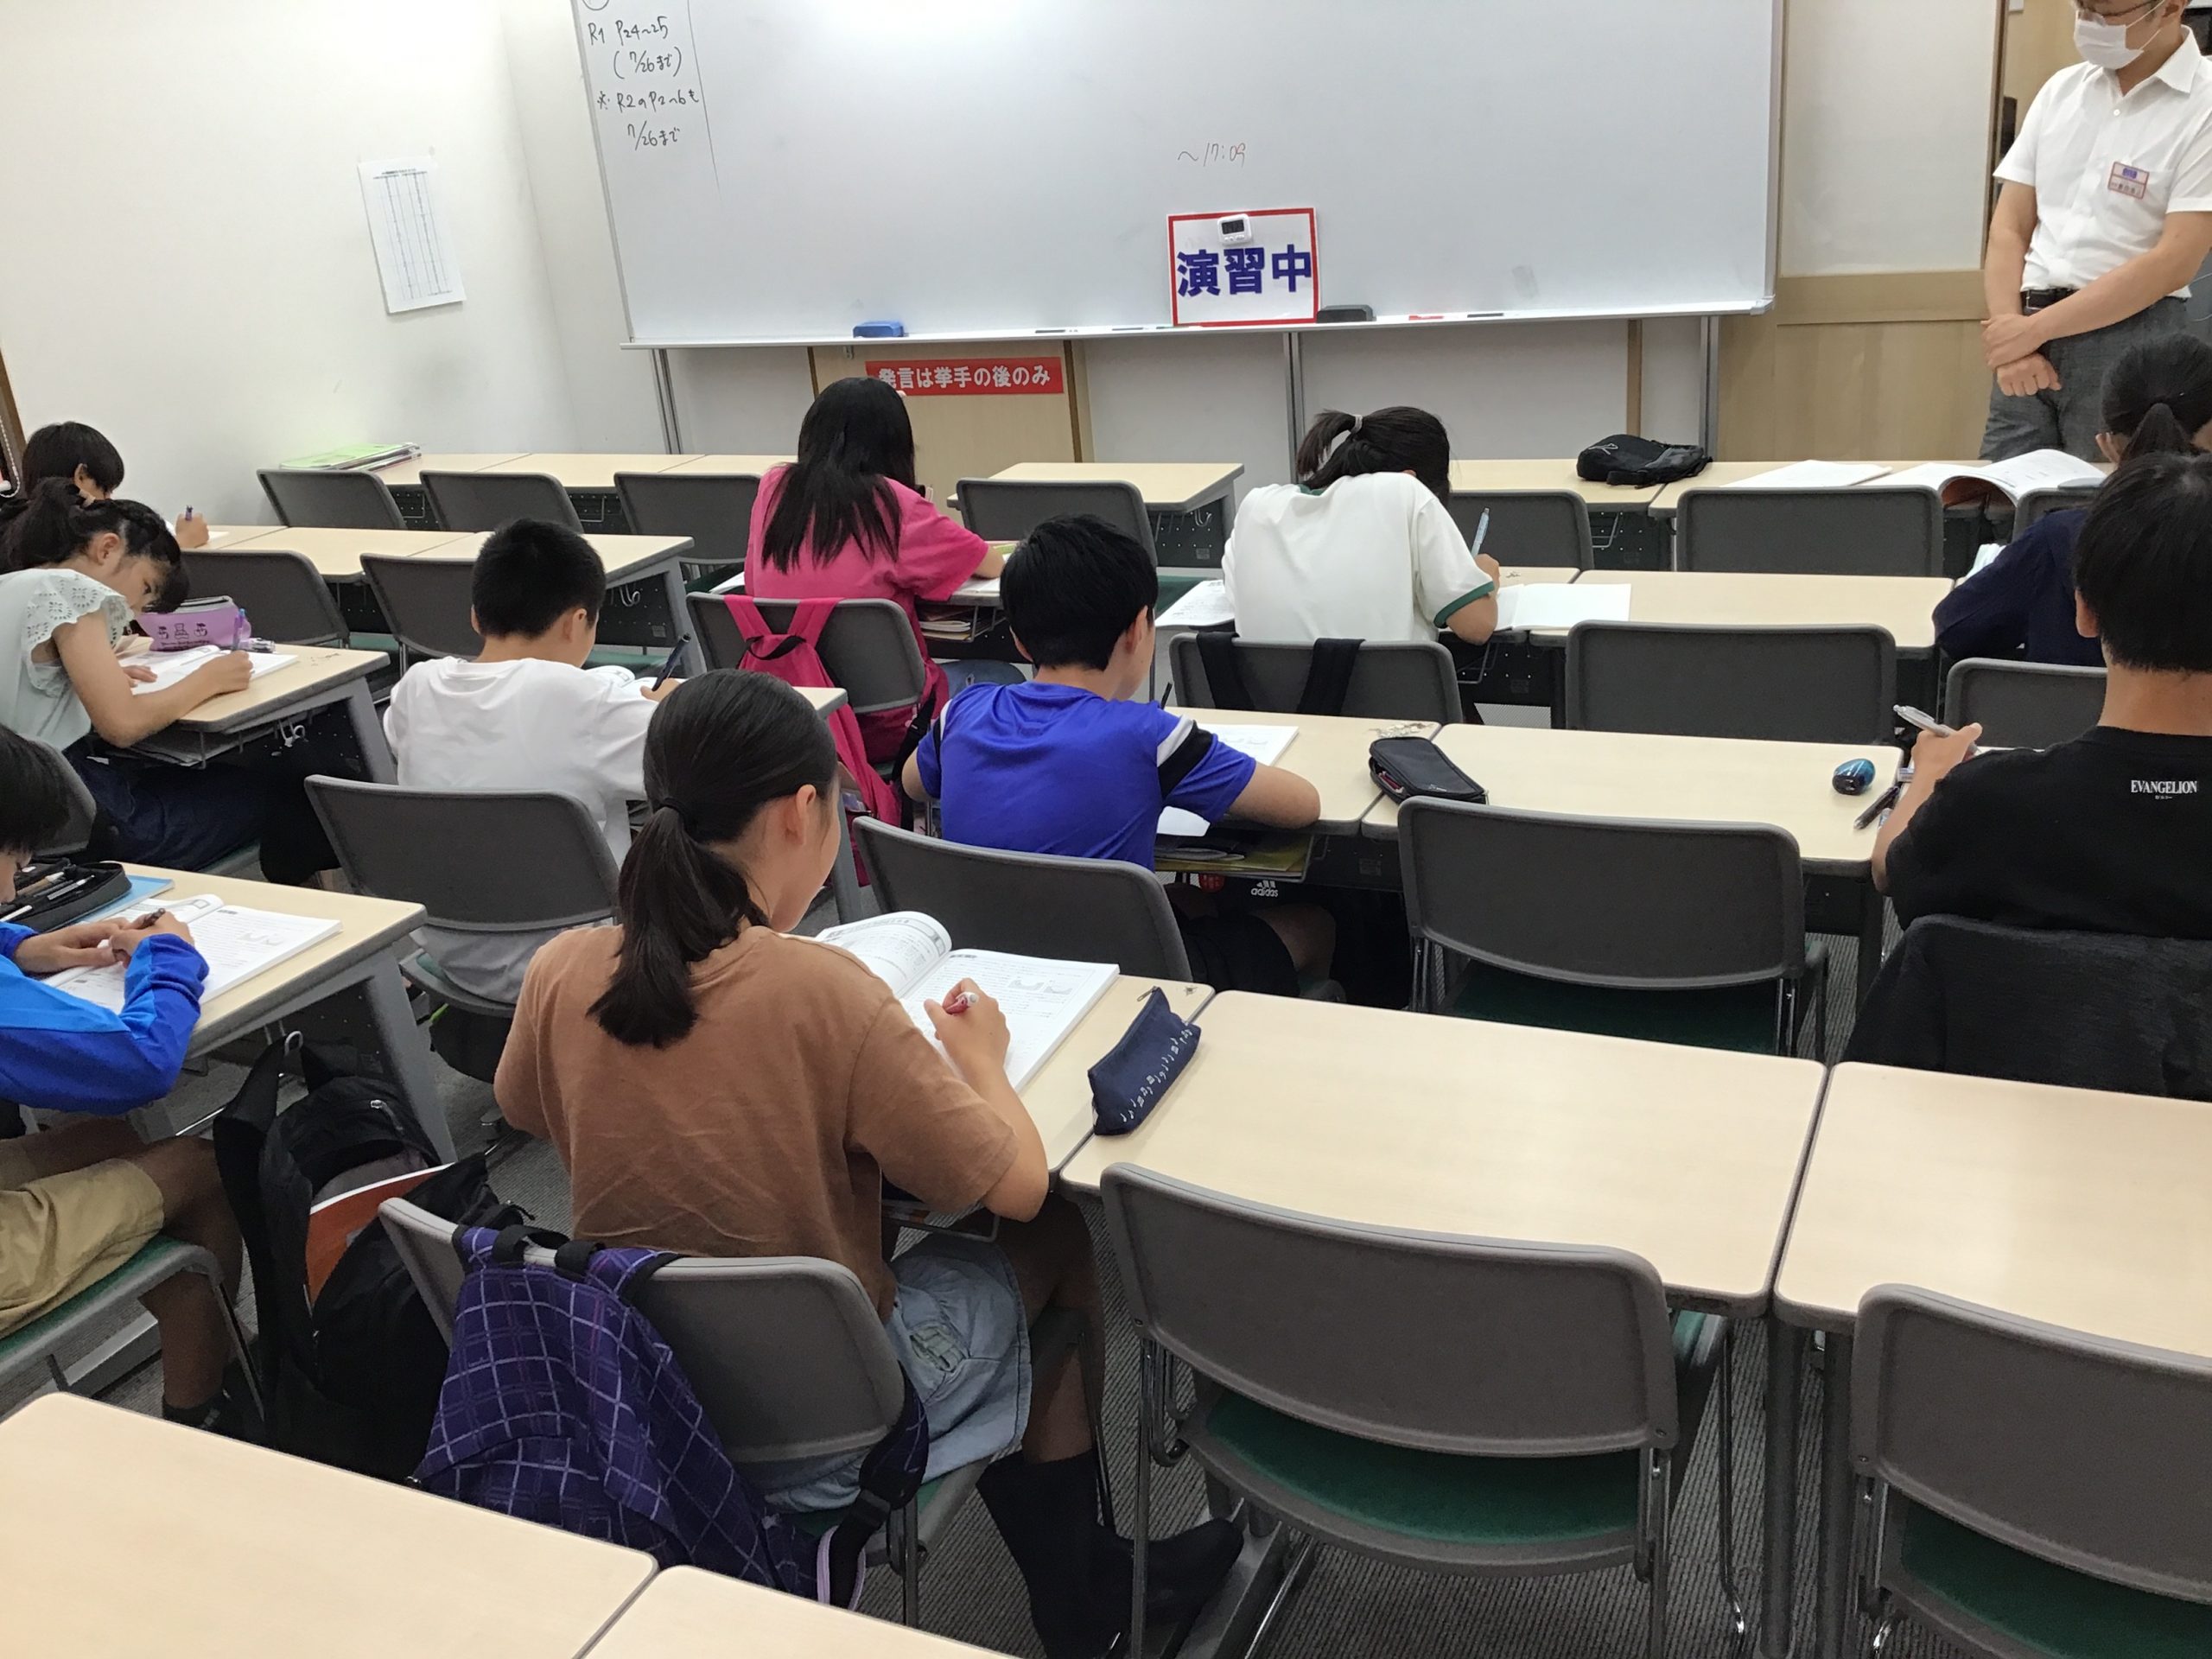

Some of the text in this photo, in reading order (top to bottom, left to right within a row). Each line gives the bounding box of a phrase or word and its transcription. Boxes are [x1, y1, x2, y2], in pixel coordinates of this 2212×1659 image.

[588, 22, 606, 46] R1
[1177, 244, 1313, 297] 演習中
[878, 365, 1051, 389] 発言は挙手の後のみ
[2131, 779, 2198, 794] EVANGELION
[1250, 887, 1279, 898] adidas
